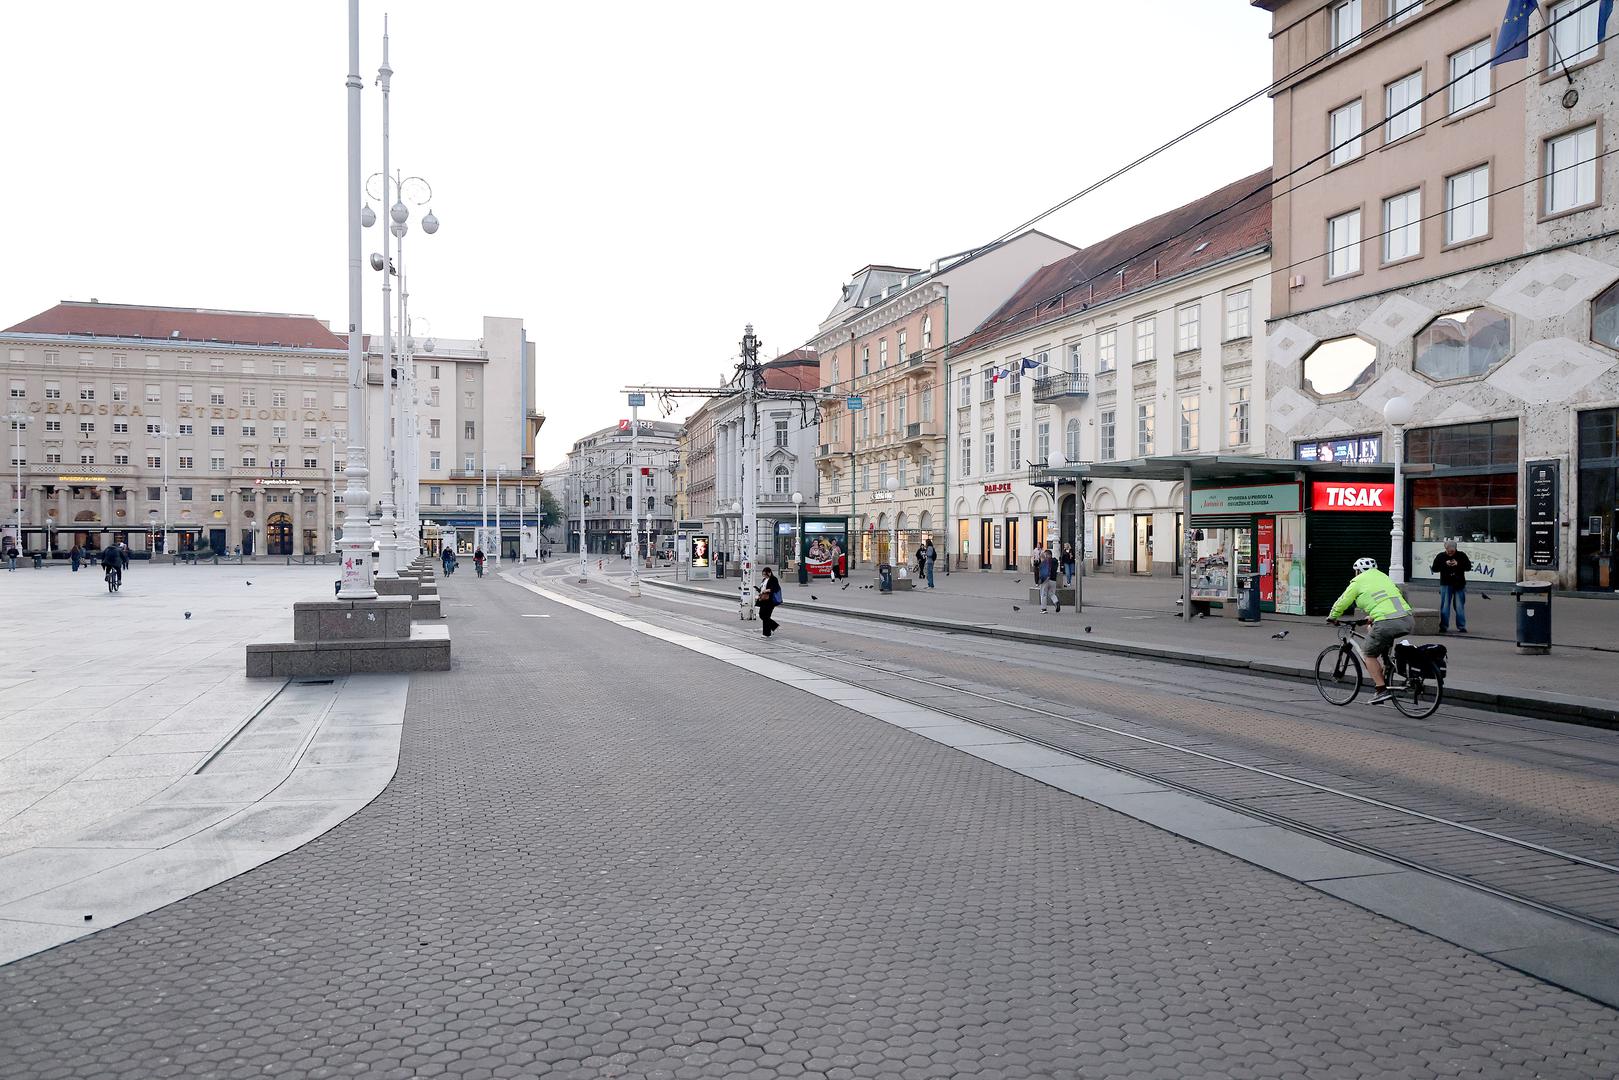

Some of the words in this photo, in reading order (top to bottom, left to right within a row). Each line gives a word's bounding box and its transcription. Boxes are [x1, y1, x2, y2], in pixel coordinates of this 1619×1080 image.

[29, 401, 143, 417] GRADSKA
[1346, 440, 1378, 459] ALEN
[827, 496, 841, 504] SINGER
[914, 487, 935, 498] SINGER
[1326, 487, 1384, 507] TISAK
[1474, 551, 1497, 565] BEST
